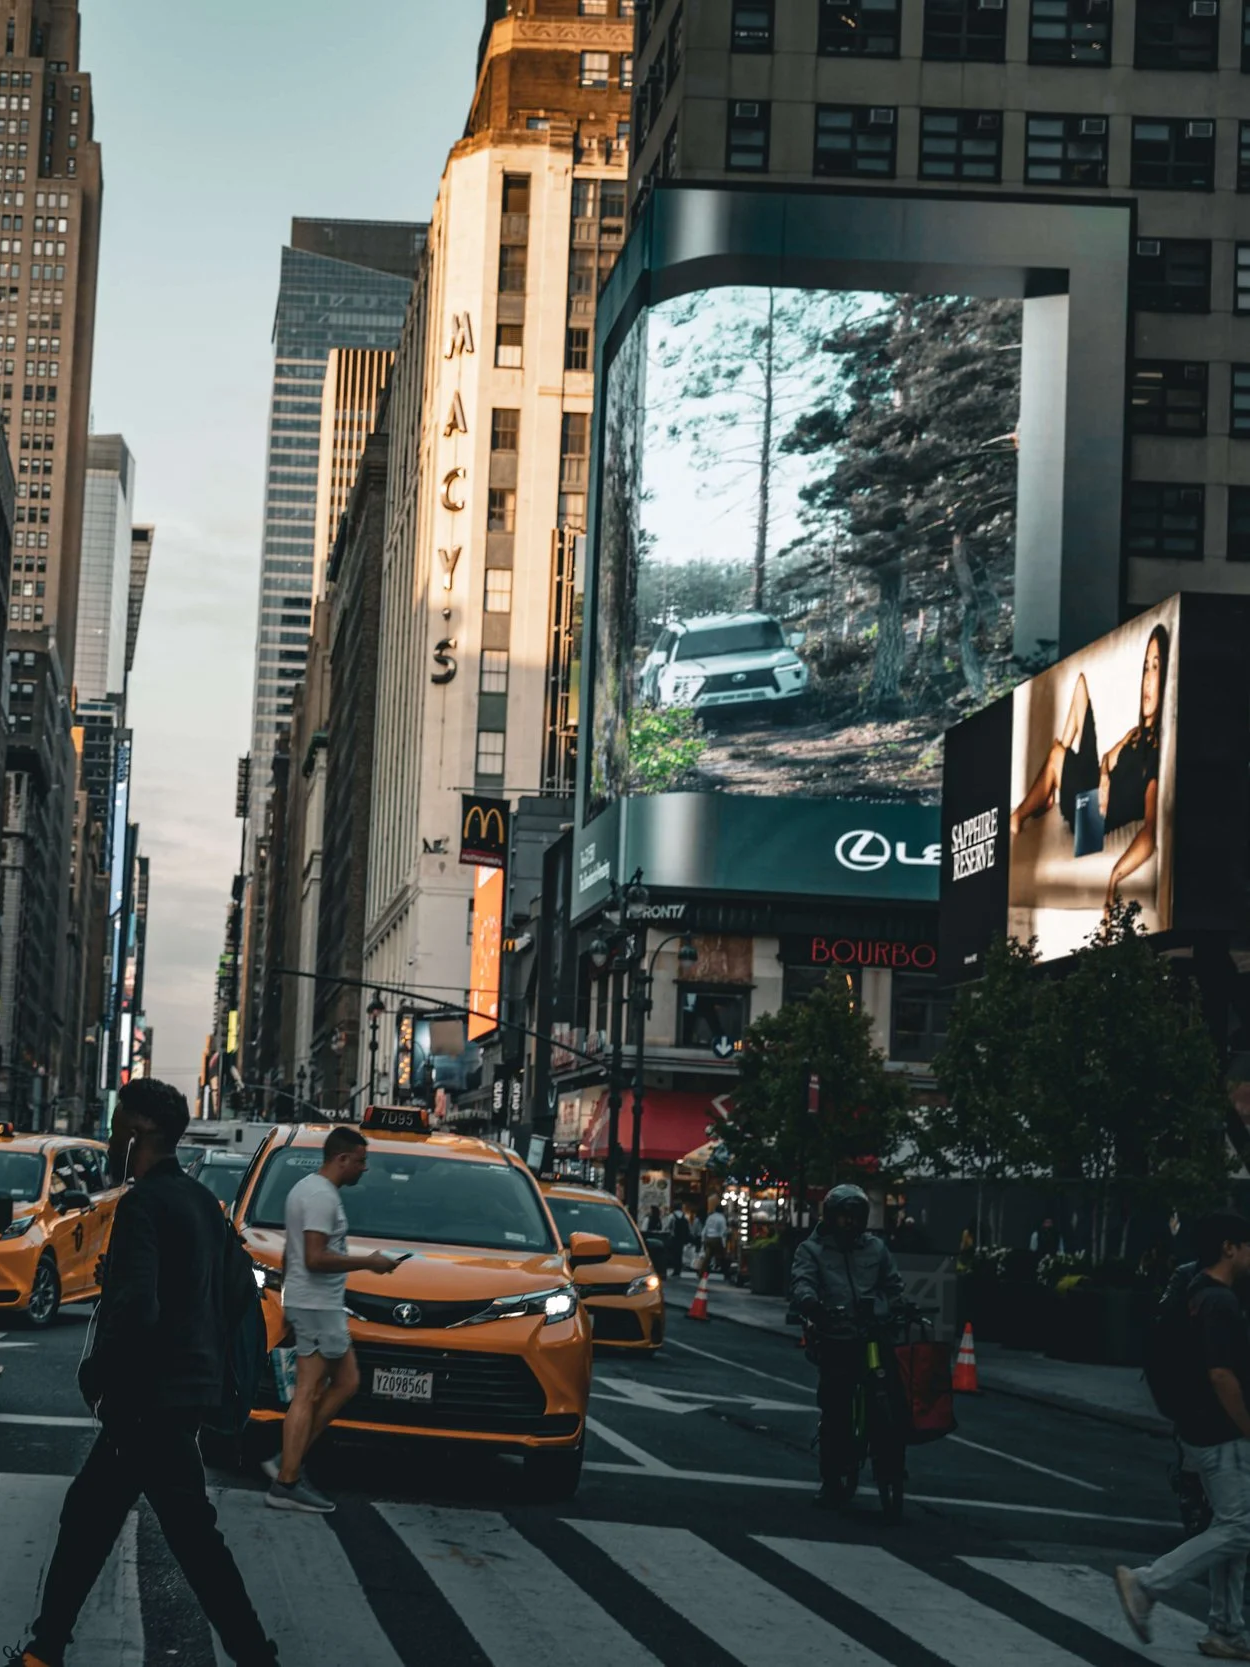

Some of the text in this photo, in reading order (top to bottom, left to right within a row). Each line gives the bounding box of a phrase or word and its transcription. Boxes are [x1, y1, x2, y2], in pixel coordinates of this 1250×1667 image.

[951, 806, 999, 854] SAPPHIRE
[952, 838, 996, 882] RESERVE
[380, 1111, 414, 1126] 7D95
